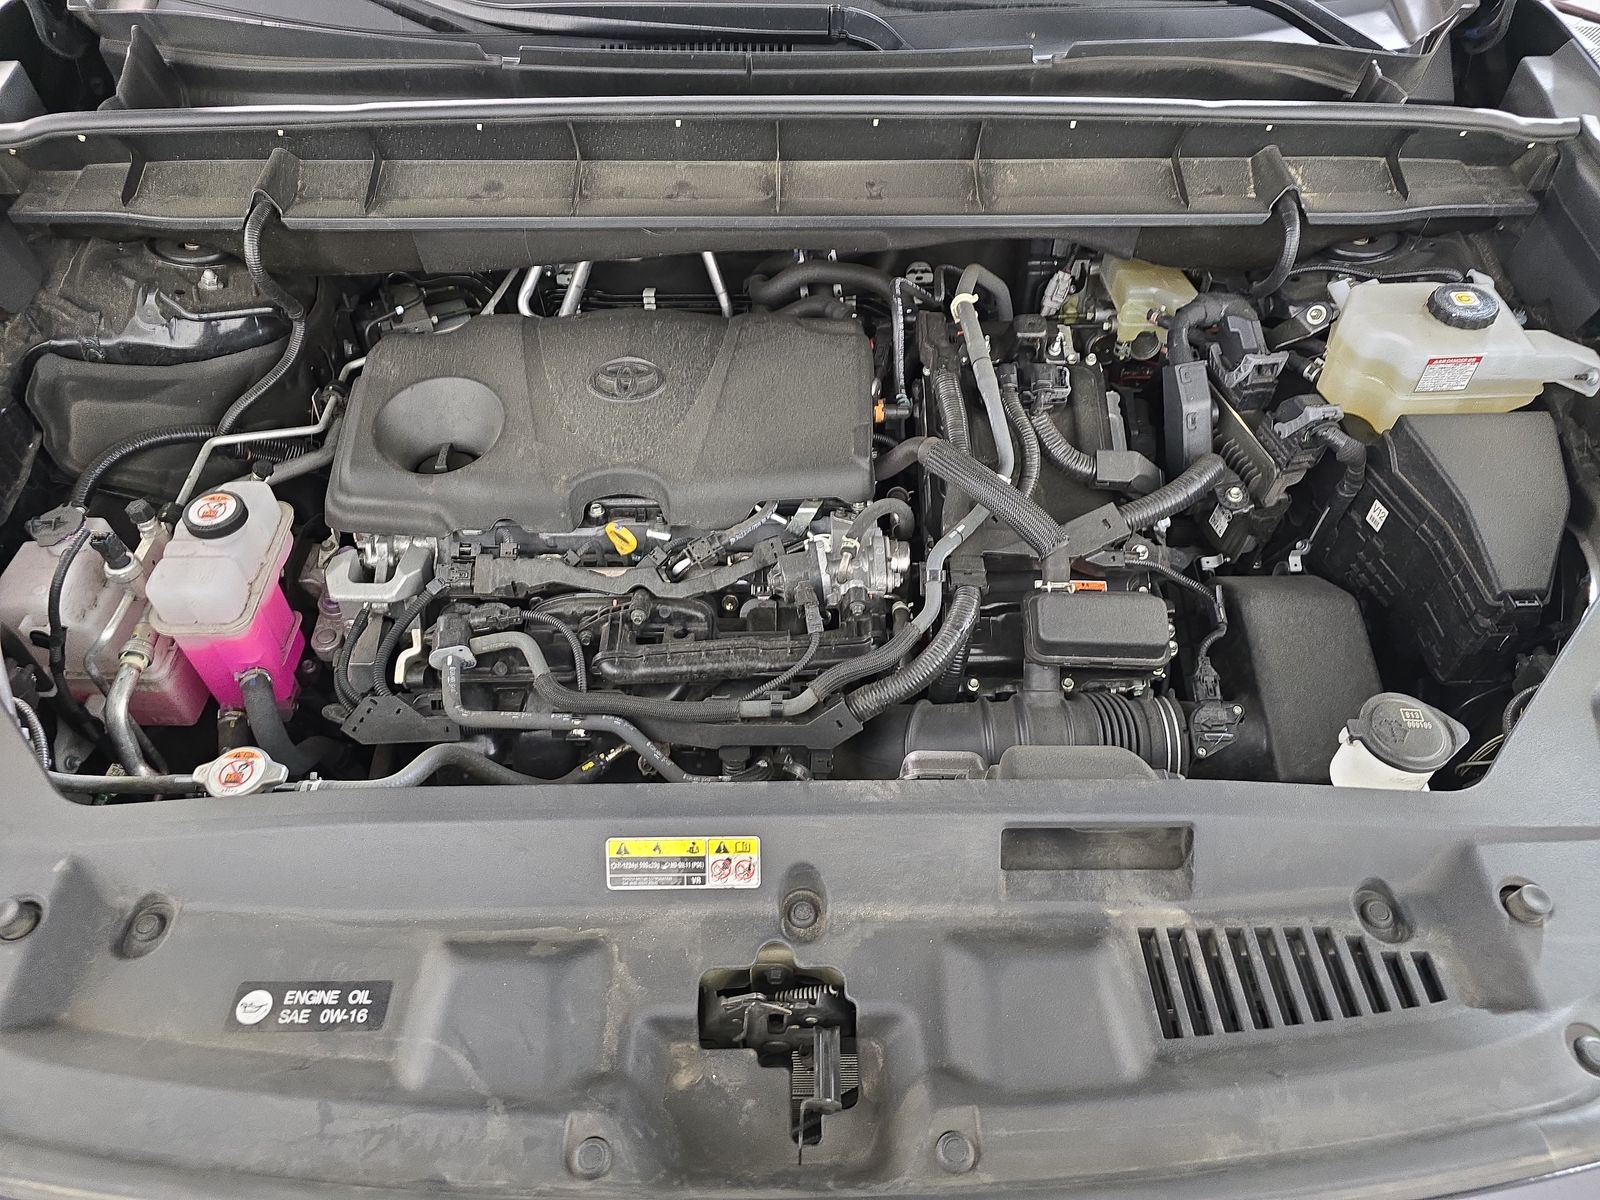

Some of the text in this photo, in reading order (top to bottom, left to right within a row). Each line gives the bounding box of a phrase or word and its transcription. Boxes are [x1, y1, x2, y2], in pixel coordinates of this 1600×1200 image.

[1374, 503, 1386, 521] V12
[283, 989, 373, 1005] ENGINE OIL
[278, 1008, 369, 1024] SAE 0W-16
